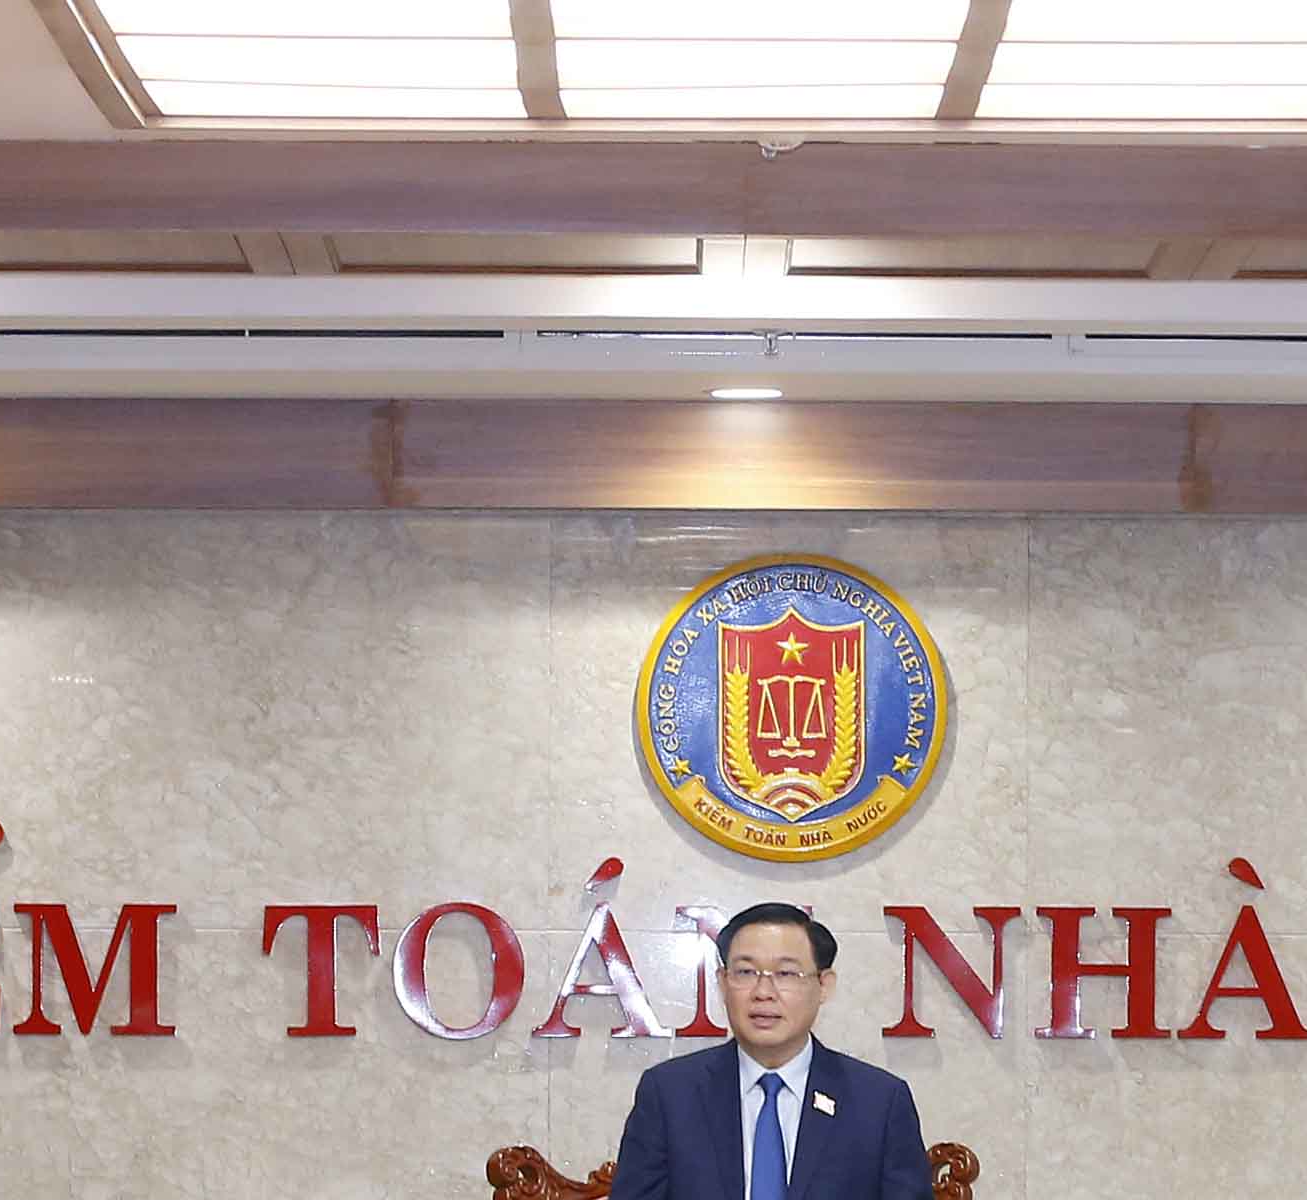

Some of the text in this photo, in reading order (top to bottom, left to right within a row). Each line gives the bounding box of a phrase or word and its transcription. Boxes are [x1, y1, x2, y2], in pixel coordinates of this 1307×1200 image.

[905, 692, 927, 750] NAM
[744, 826, 787, 846] TOÁN
[799, 824, 833, 847] NHÀ
